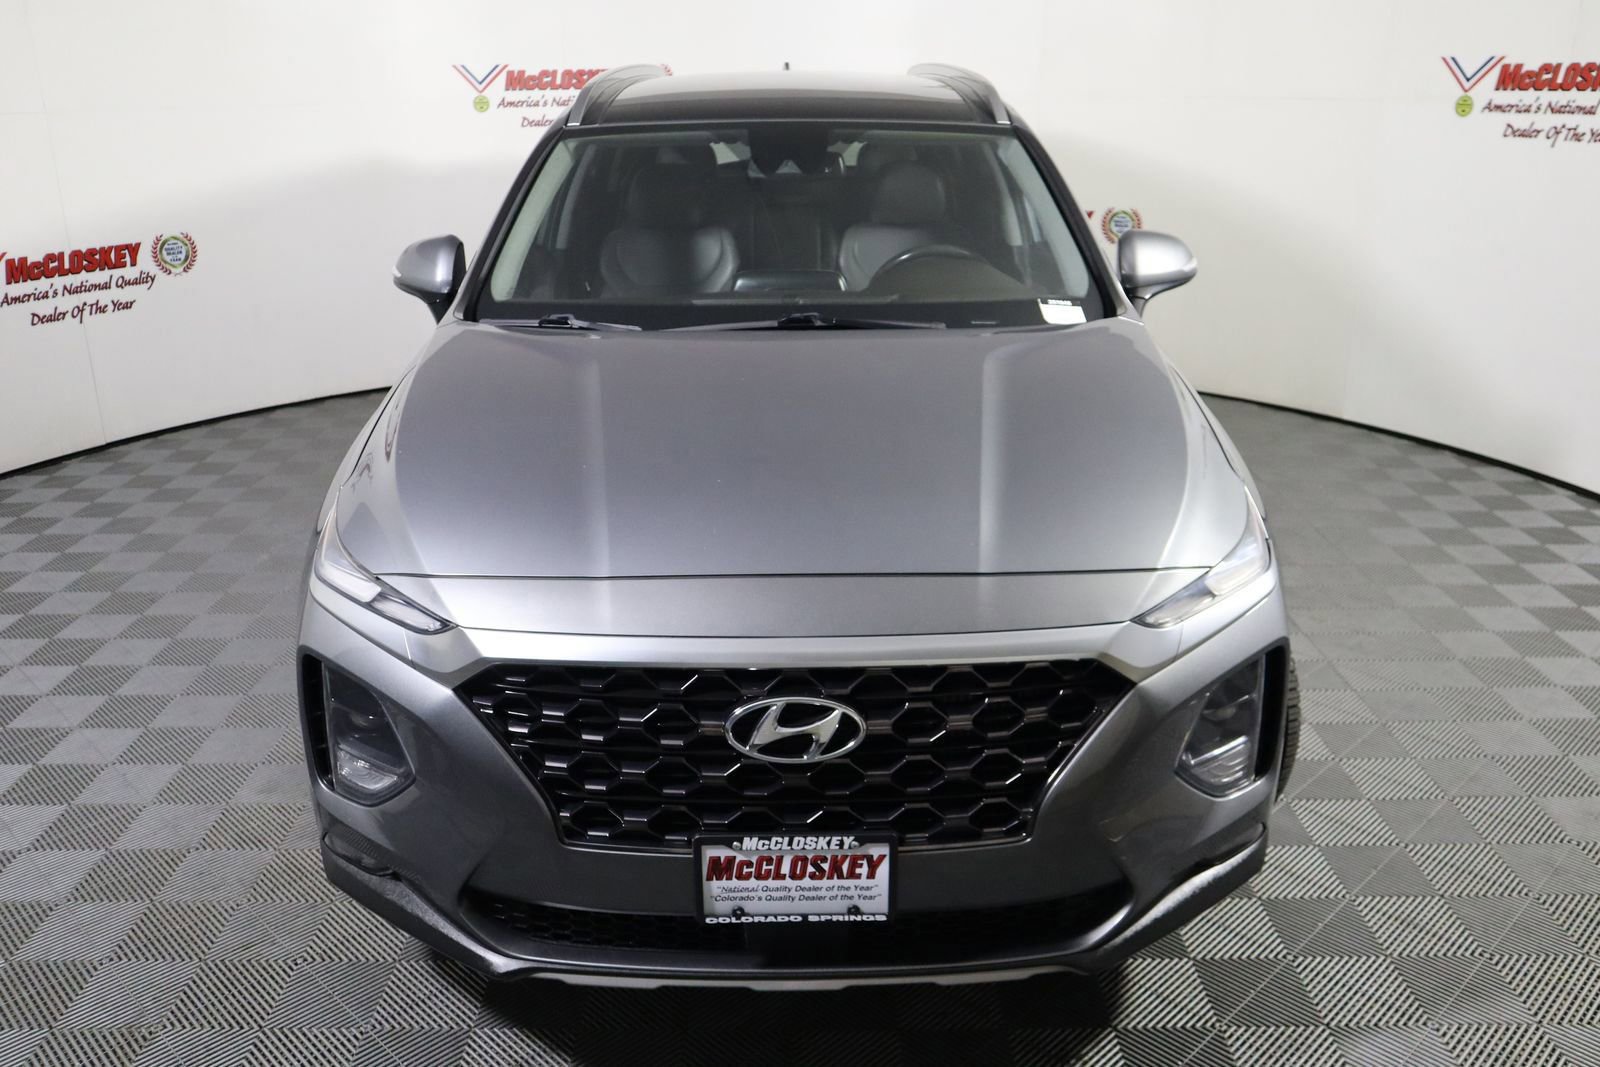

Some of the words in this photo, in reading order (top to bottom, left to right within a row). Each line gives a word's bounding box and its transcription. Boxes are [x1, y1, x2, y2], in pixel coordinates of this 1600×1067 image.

[497, 95, 548, 109] America's
[1480, 96, 1542, 114] America's
[1544, 99, 1600, 115] National
[1503, 121, 1544, 139] Dealer
[1545, 124, 1566, 148] Of
[1563, 124, 1587, 143] The
[5, 242, 142, 285] McCLOSKEY
[0, 283, 58, 308] America's
[62, 273, 113, 297] National
[115, 270, 157, 290] Quality
[31, 306, 69, 326] Dealer
[71, 302, 87, 324] Of
[88, 300, 109, 317] The
[111, 299, 136, 313] Year
[741, 836, 856, 851] McCLOSKEY
[705, 853, 887, 882] McCLOSKEY
[761, 885, 792, 894] Quality
[795, 884, 824, 893] Dealer
[825, 884, 835, 892] of
[837, 884, 851, 892] the
[765, 894, 796, 903] Quality
[798, 894, 828, 902] Dealer
[829, 893, 838, 901] of
[840, 893, 854, 901] the
[705, 915, 803, 924] COLORADO
[808, 914, 887, 922] SPRINGS
